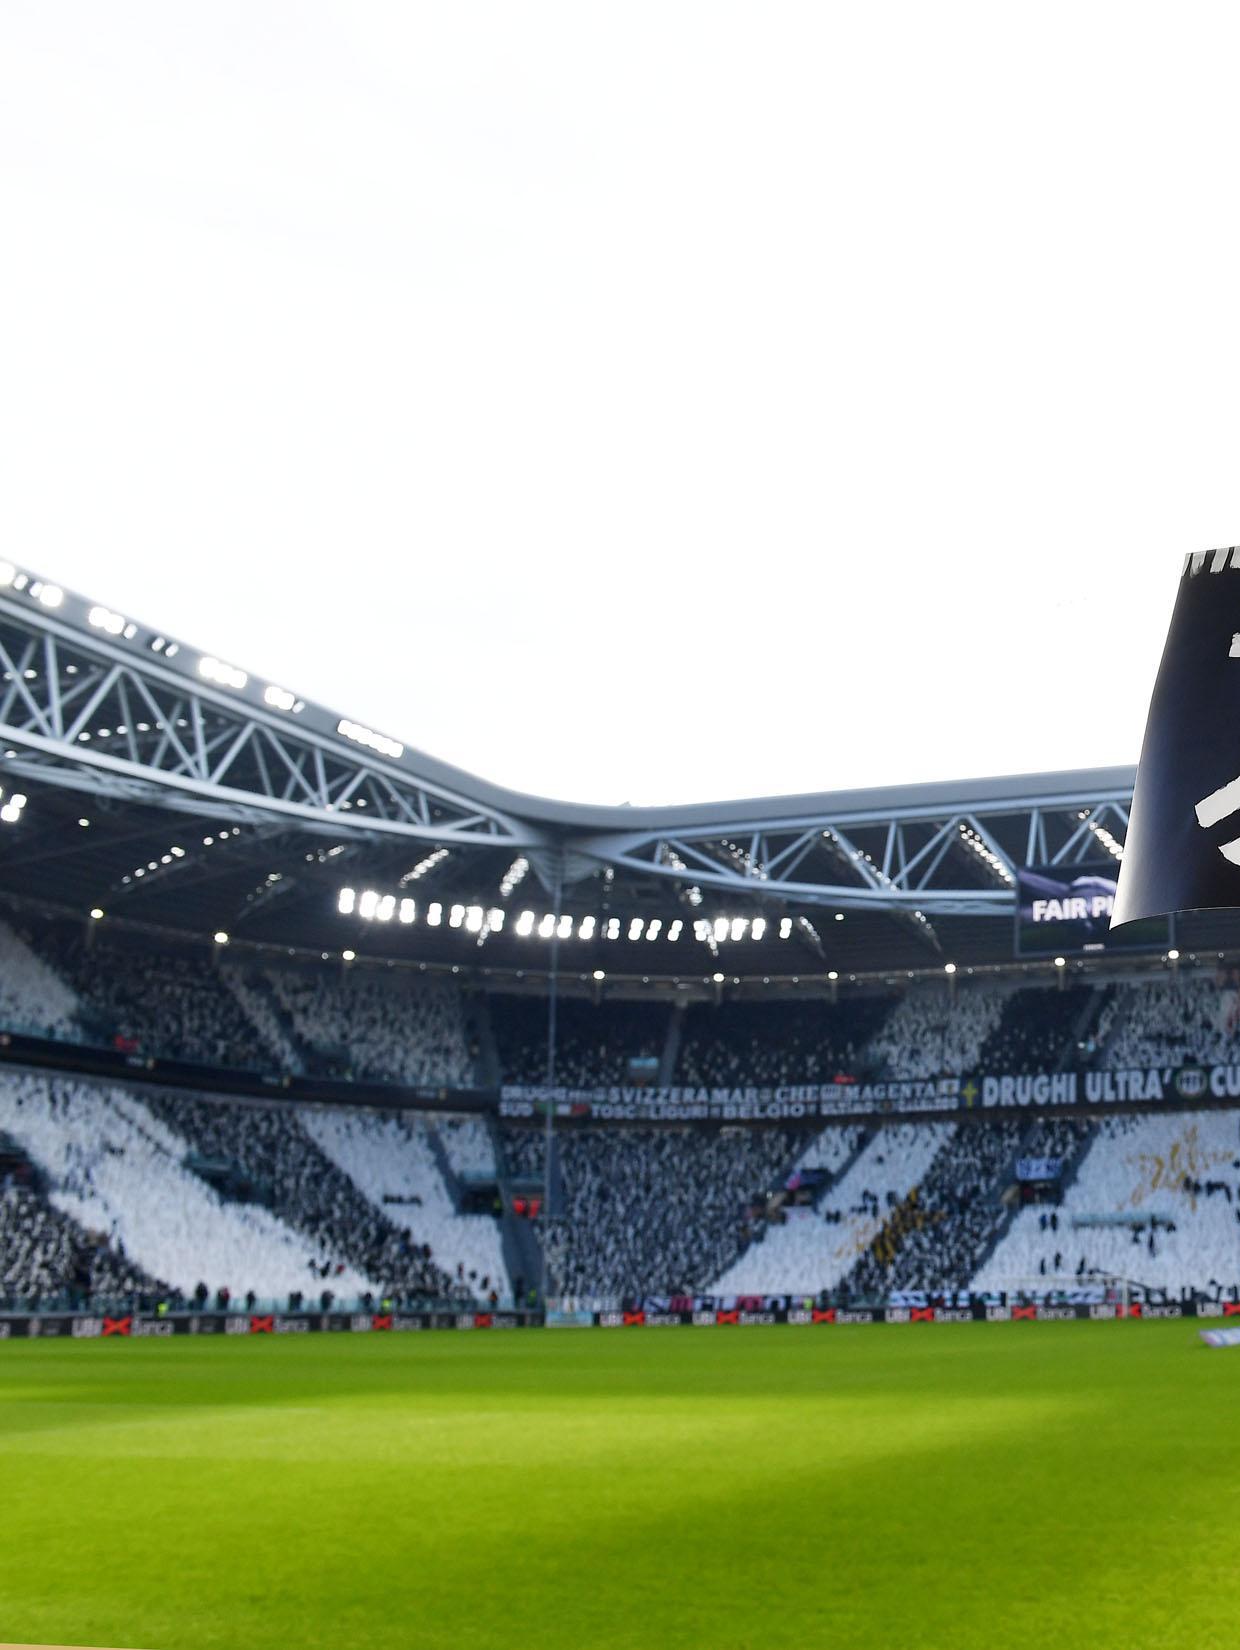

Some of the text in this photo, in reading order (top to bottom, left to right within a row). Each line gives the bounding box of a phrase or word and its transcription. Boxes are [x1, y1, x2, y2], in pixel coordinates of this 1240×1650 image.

[1032, 897, 1088, 922] FAIR
[608, 1087, 709, 1104] SVIZZERA
[845, 1082, 938, 1102] MAGENTA
[981, 1072, 1078, 1107] DRUGHI
[1085, 1068, 1172, 1102] ULTRA'
